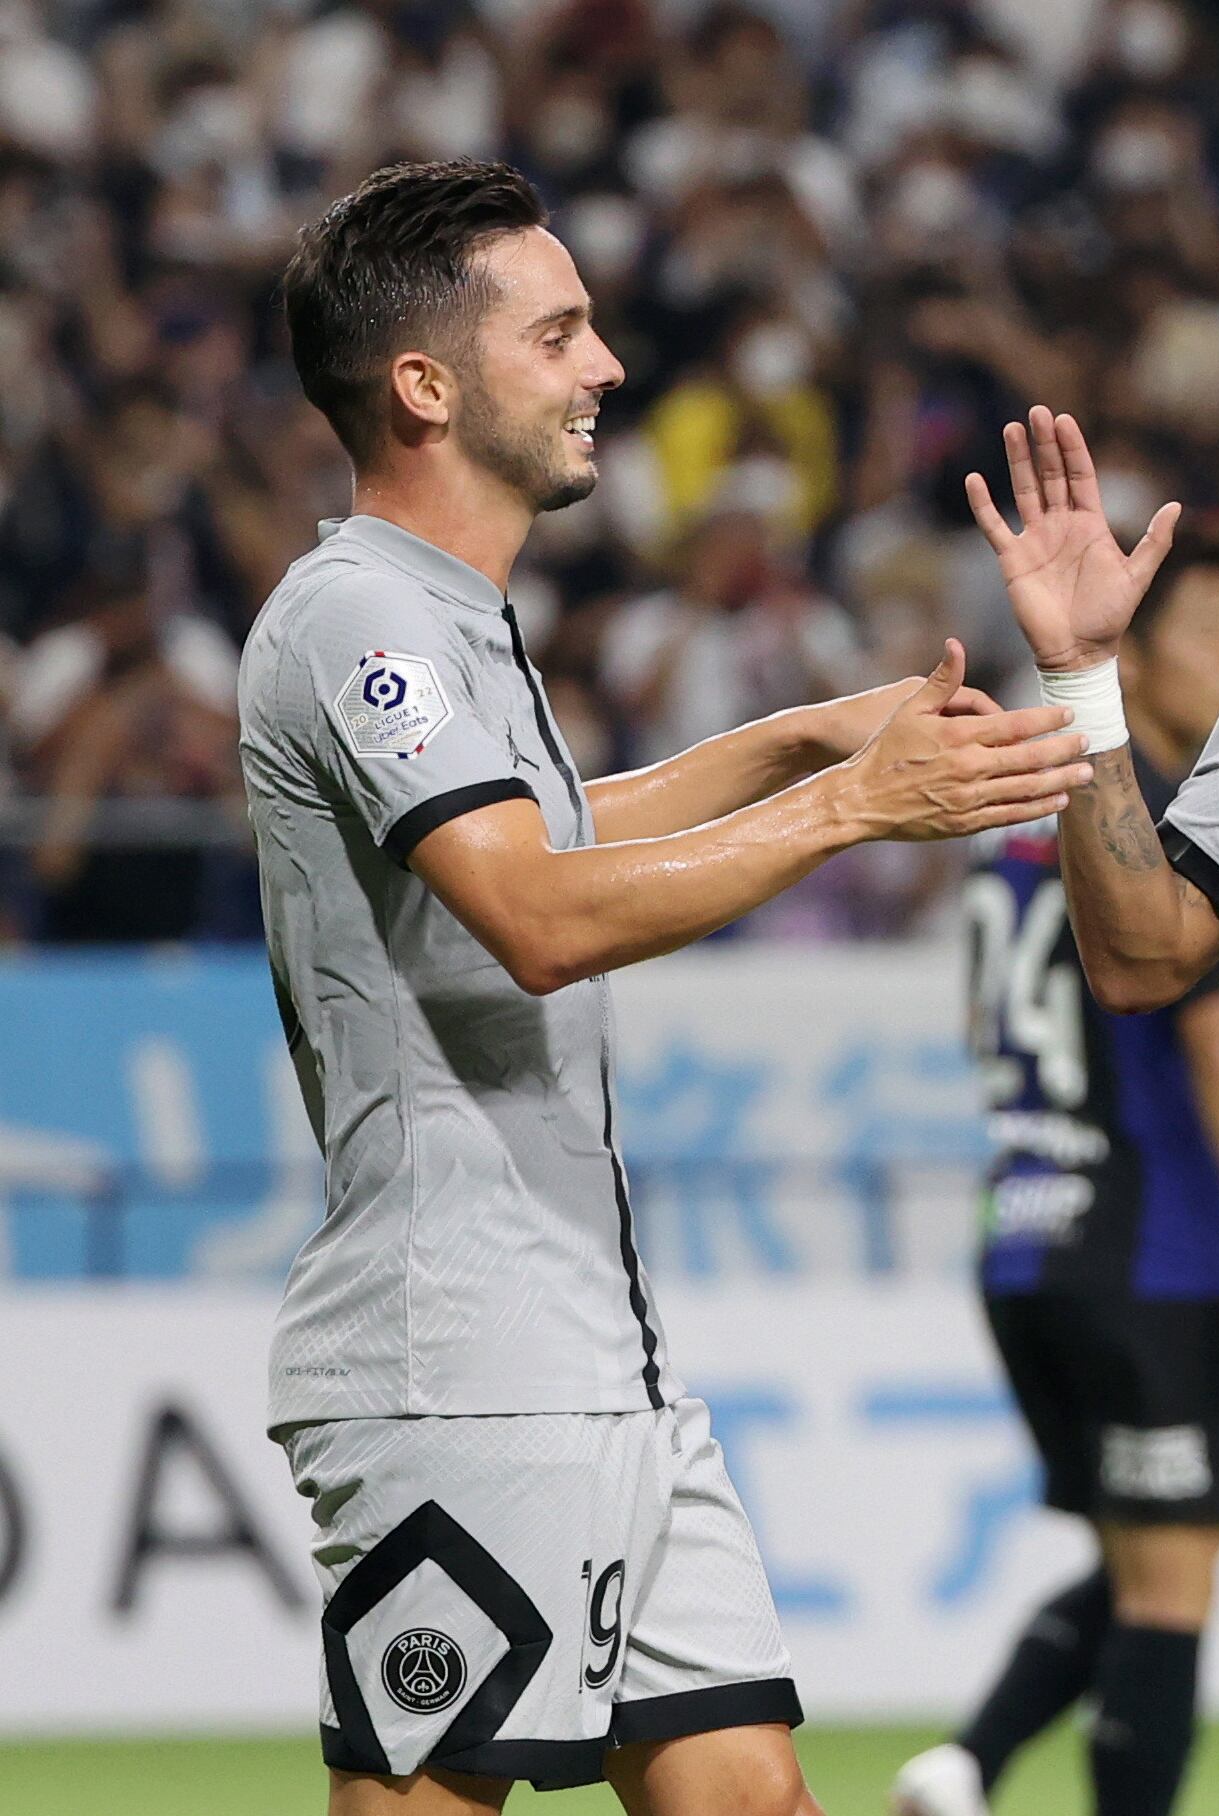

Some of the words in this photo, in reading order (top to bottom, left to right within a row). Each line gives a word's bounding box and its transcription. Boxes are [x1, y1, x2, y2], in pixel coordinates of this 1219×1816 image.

[373, 727, 398, 744] Uber
[401, 715, 430, 731] Eats
[374, 709, 411, 730] LIGUE
[578, 1558, 626, 1694] 19
[397, 1634, 451, 1656] PARIS
